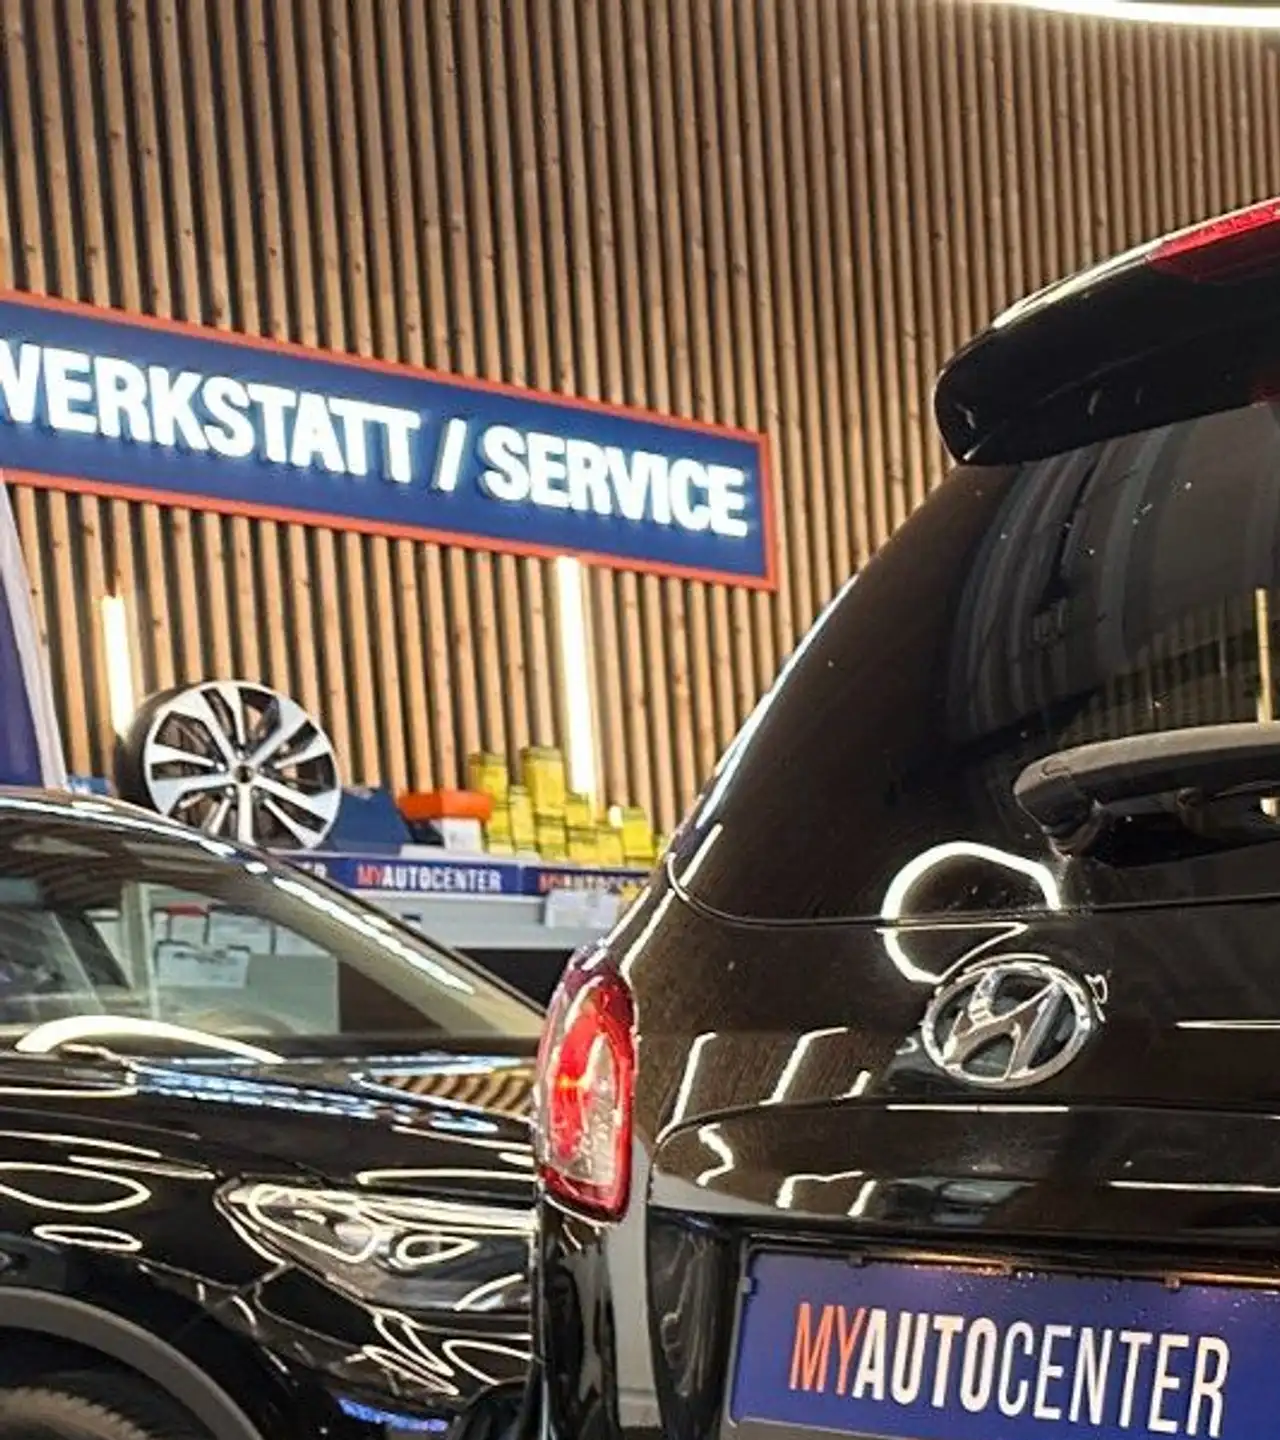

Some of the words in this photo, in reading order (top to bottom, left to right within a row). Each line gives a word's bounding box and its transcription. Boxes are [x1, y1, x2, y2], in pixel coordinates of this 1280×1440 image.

[438, 418, 467, 492] /
[483, 424, 748, 537] SERVICE
[357, 864, 501, 891] MYAUTOCENTER
[789, 1302, 1230, 1438] MYAUTOCENTER
